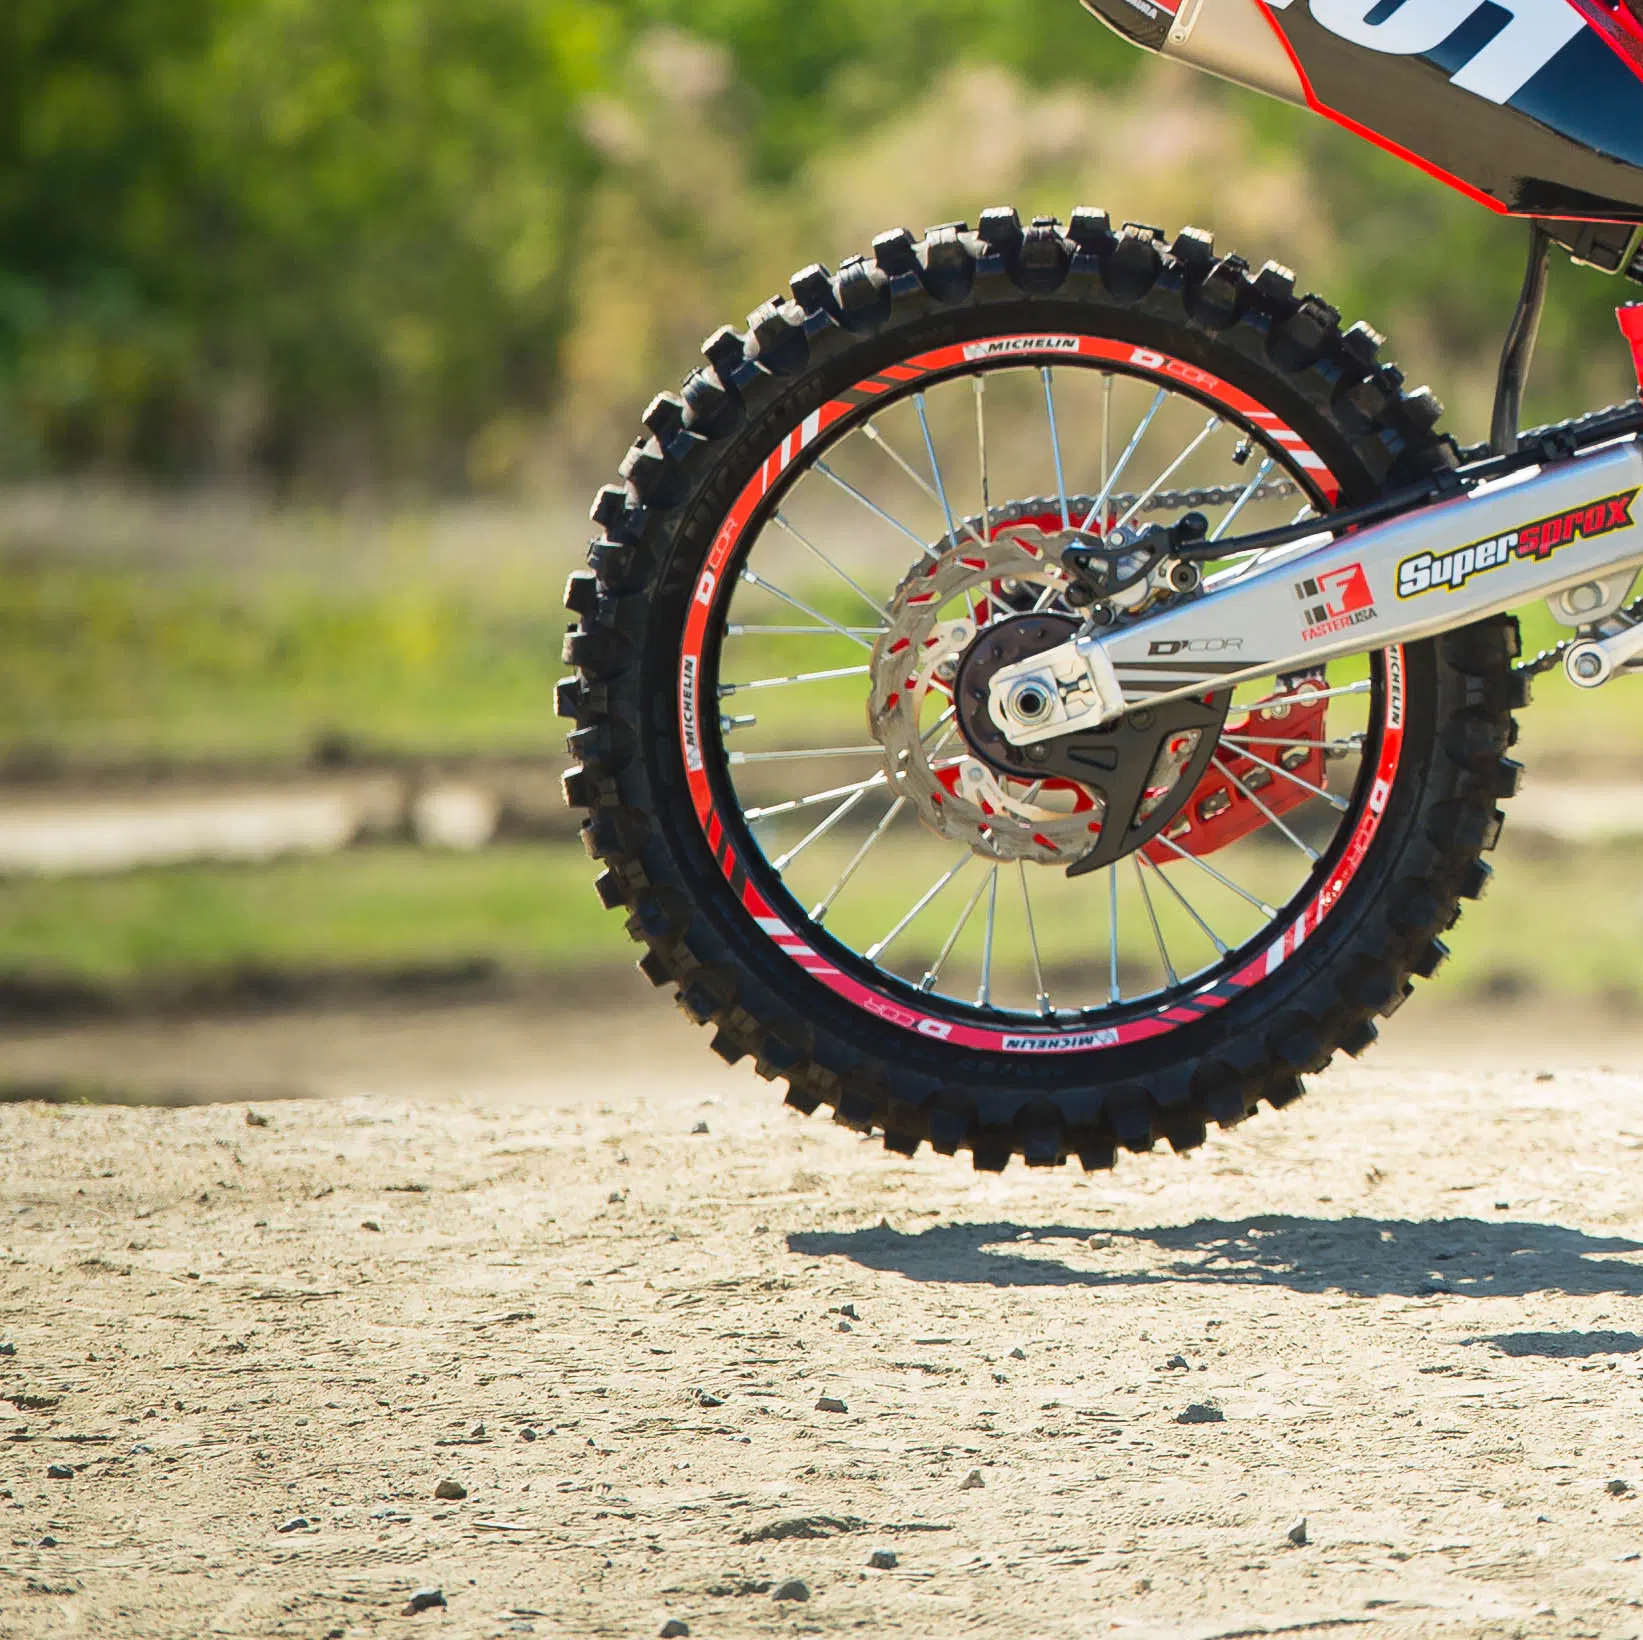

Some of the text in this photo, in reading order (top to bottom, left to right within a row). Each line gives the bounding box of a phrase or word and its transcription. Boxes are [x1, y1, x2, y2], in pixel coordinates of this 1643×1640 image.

[988, 338, 1076, 353] MICHELIN
[1400, 496, 1630, 597] Supersprox
[681, 659, 695, 748] MICHELIN
[1006, 1036, 1094, 1050] MICHELIN
